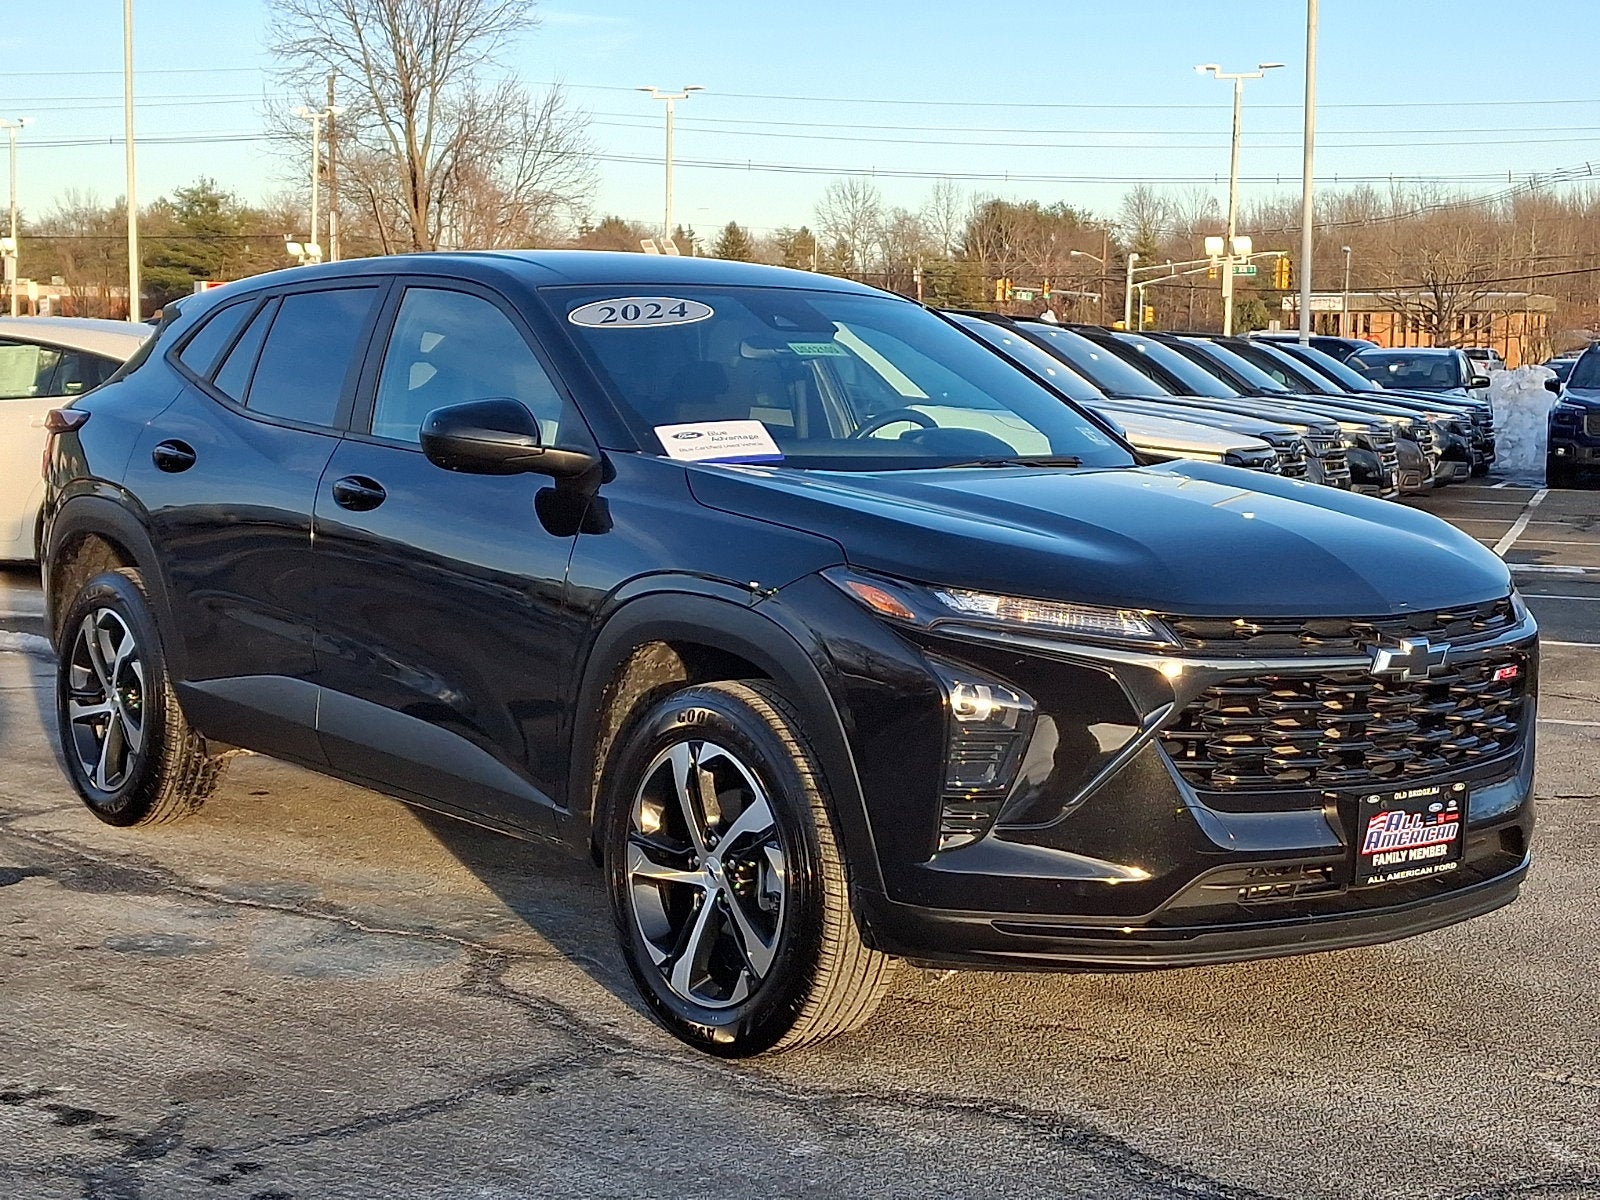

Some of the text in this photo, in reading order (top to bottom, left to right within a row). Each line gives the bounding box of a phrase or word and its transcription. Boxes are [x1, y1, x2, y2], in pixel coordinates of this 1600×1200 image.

[599, 302, 689, 323] 2024
[711, 434, 759, 442] Advantage
[1493, 665, 1518, 681] RS
[1394, 791, 1408, 800] OLD
[1372, 844, 1448, 866] FAMILY MEMBER
[1367, 862, 1457, 884] ALL AMERICAN FORD
